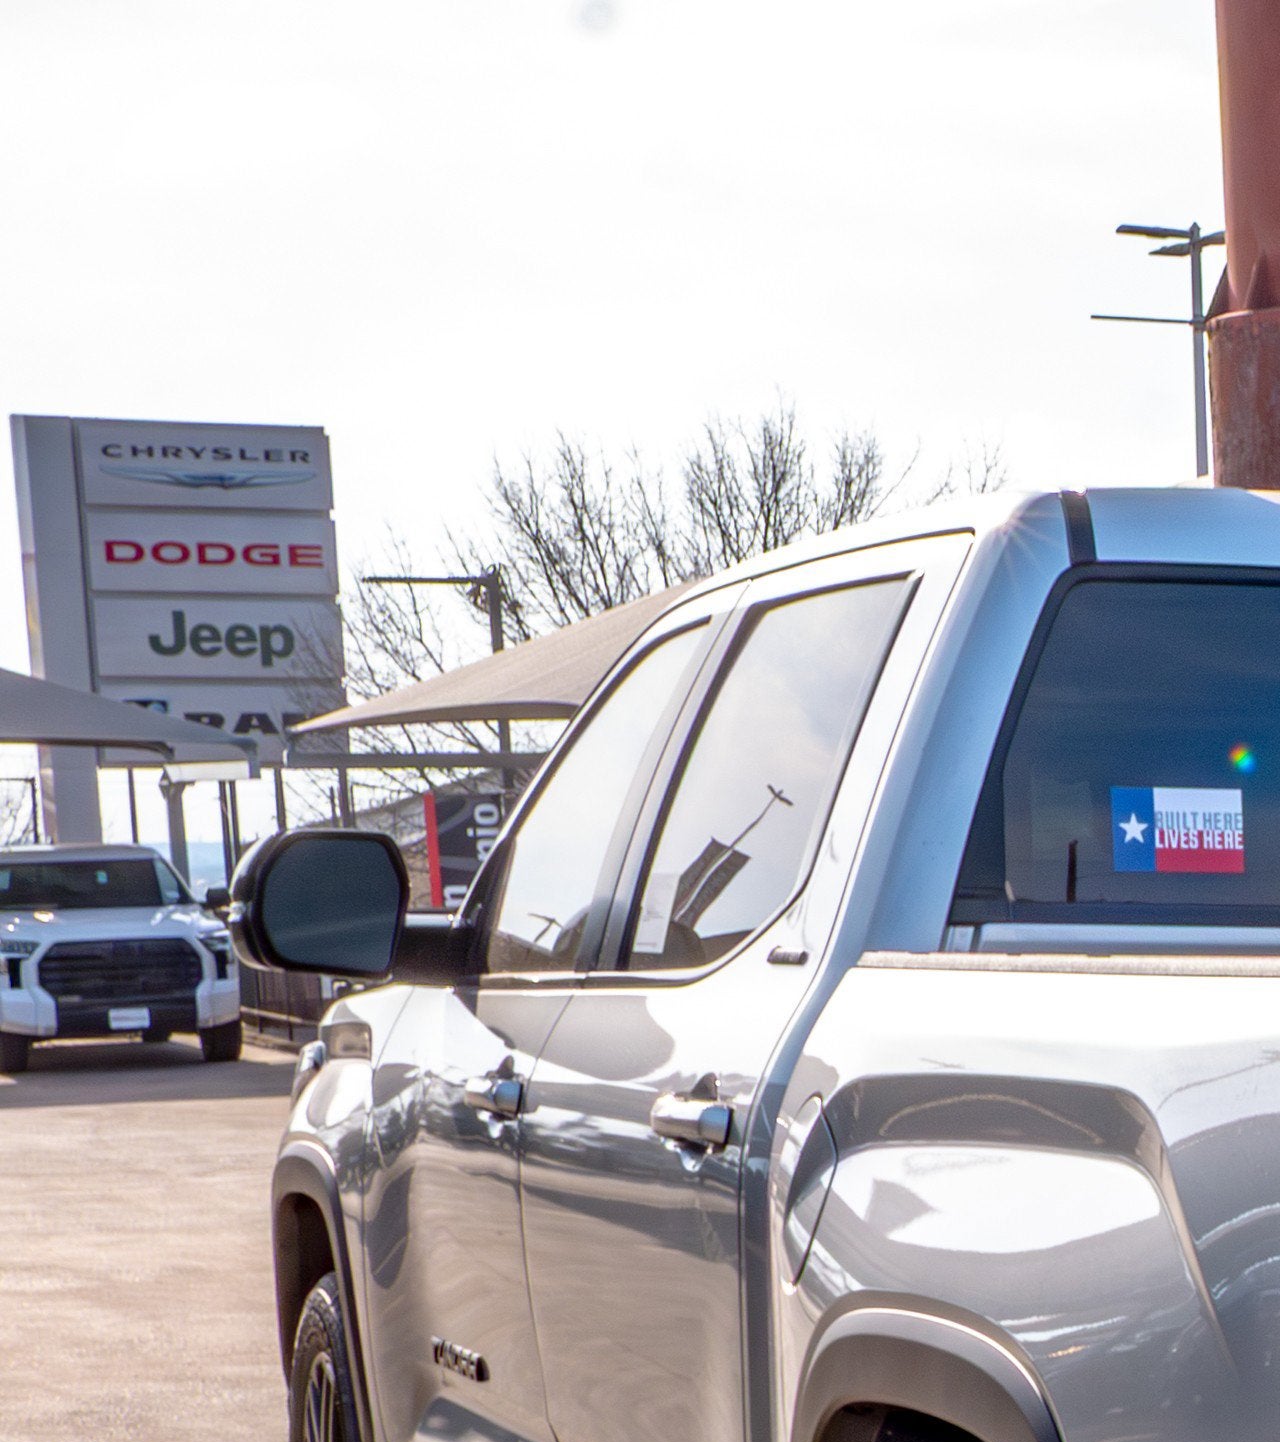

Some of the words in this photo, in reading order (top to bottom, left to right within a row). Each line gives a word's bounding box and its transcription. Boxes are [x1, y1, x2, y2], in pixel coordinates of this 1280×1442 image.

[101, 443, 312, 464] CHRYSLER
[104, 540, 325, 568] DODGE
[148, 609, 296, 668] Jeep
[1154, 810, 1200, 830] BUILT
[1202, 811, 1244, 831] HERE
[1154, 829, 1199, 850] LIVES
[1202, 829, 1244, 850] HERE
